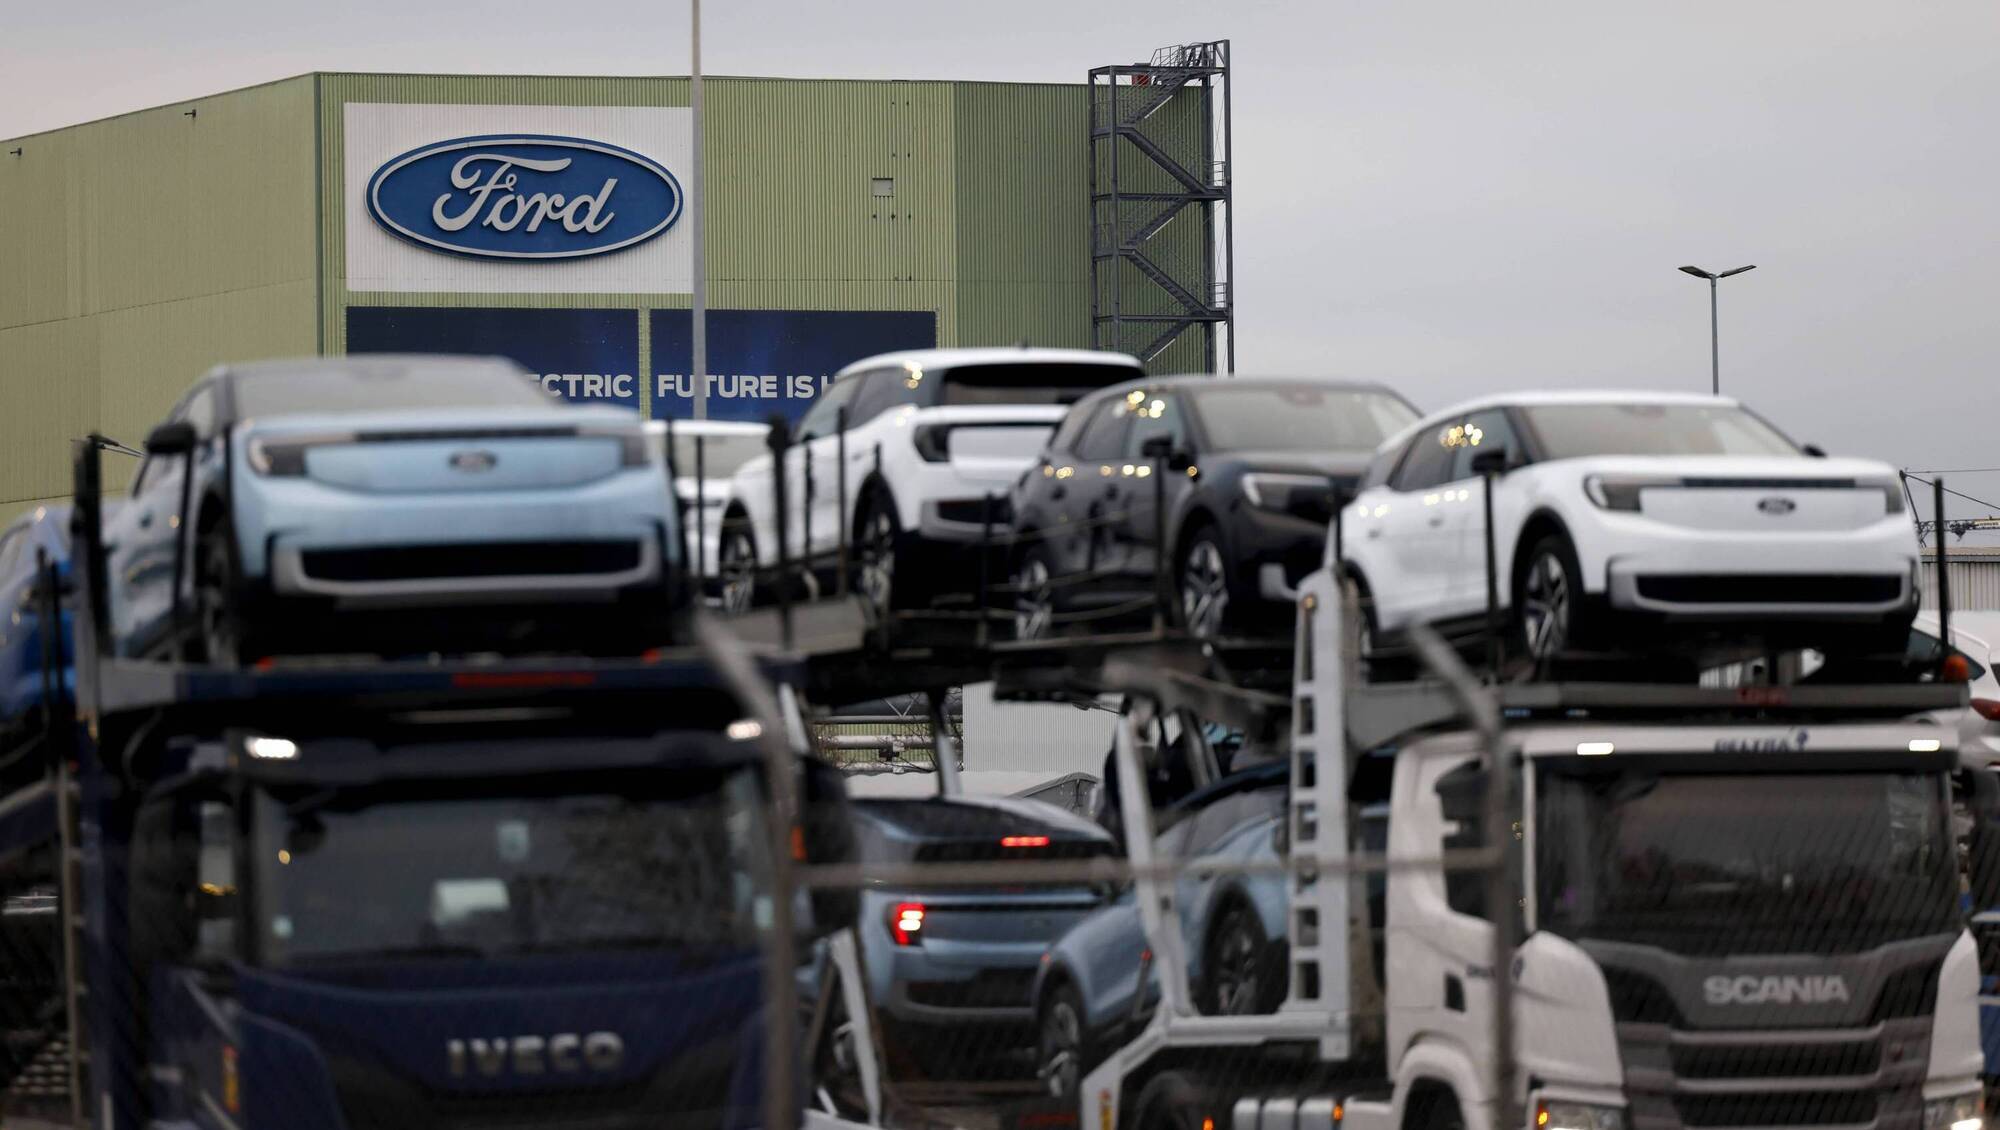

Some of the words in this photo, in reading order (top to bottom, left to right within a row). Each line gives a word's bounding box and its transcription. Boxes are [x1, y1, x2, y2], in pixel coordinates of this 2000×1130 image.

[432, 153, 618, 233] Ford
[525, 373, 633, 398] CTRIC
[657, 374, 778, 398] FUTURE
[786, 375, 815, 399] IS
[1703, 974, 1850, 1005] SCANIA
[448, 1031, 624, 1077] IVECO
